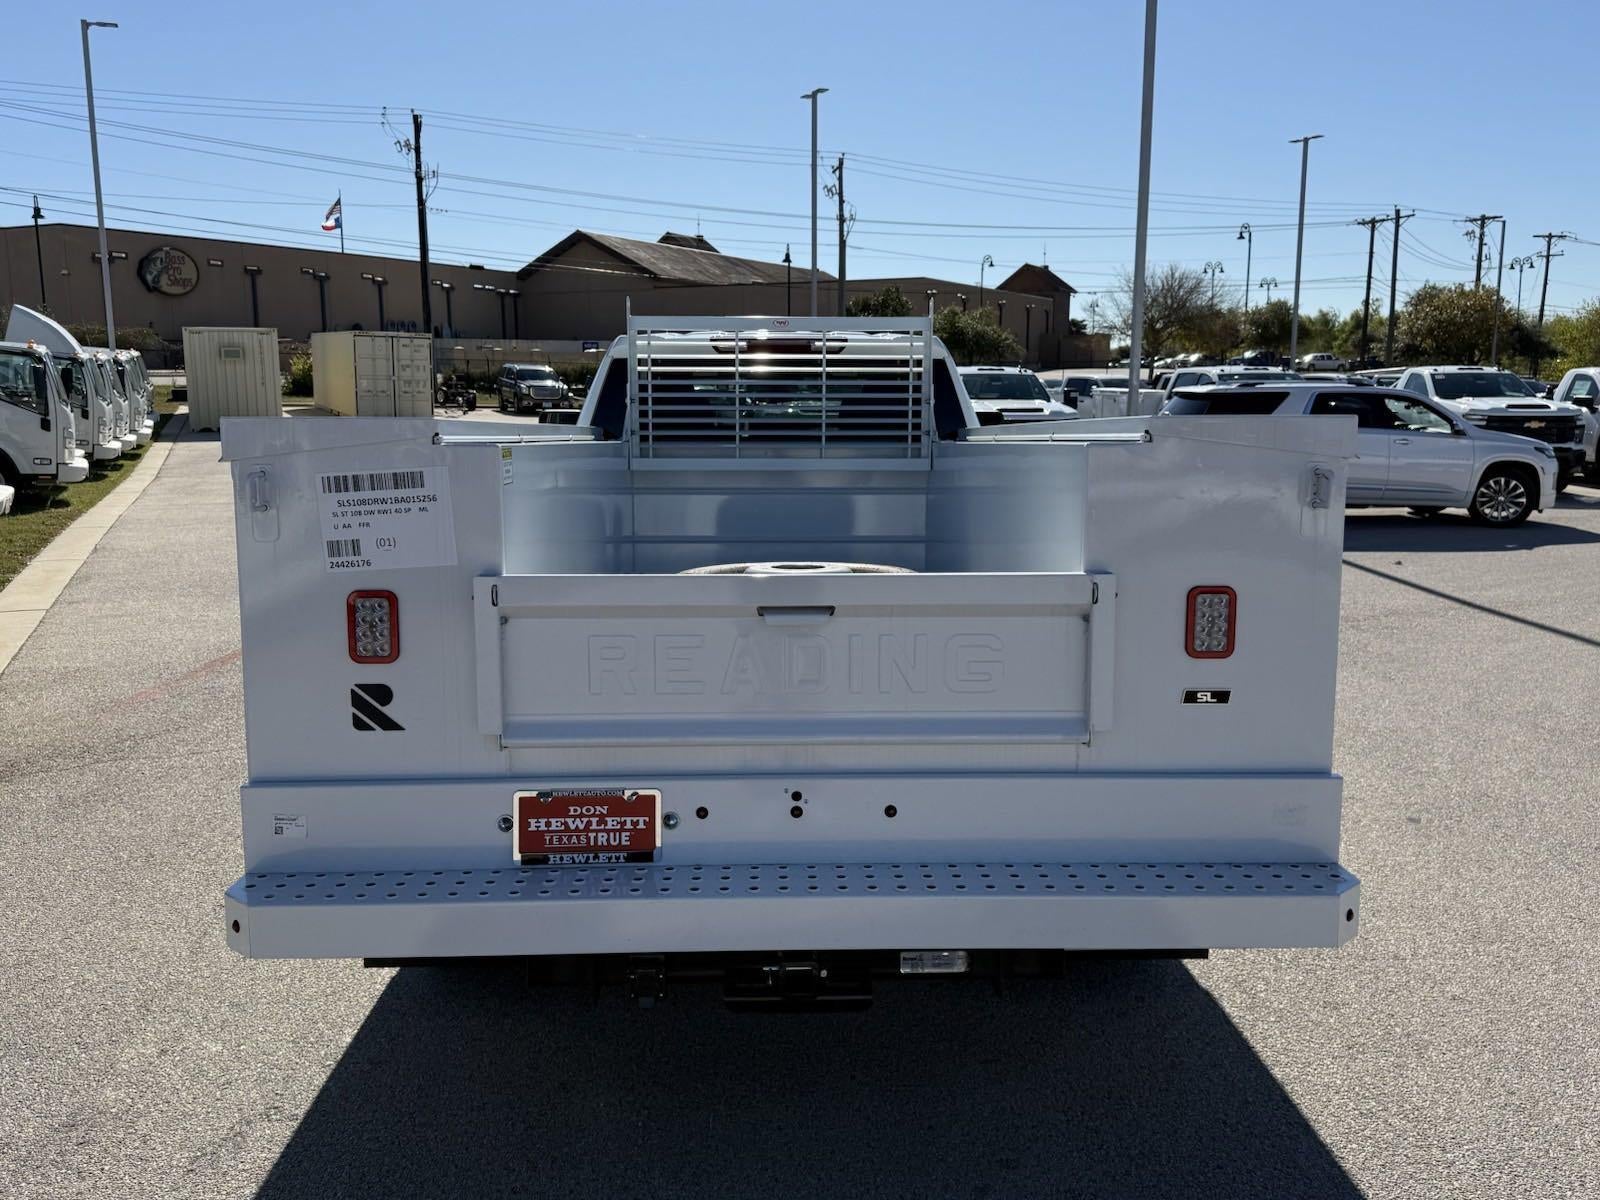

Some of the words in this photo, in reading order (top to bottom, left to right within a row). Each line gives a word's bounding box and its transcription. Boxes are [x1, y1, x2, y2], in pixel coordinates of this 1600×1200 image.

[364, 508, 376, 516] DW
[330, 559, 372, 569] 24426176
[587, 633, 1005, 695] READING
[1196, 692, 1217, 702] SL
[567, 805, 609, 816] DON
[527, 816, 650, 832] HEWLETT
[547, 852, 628, 865] HEWLETT
